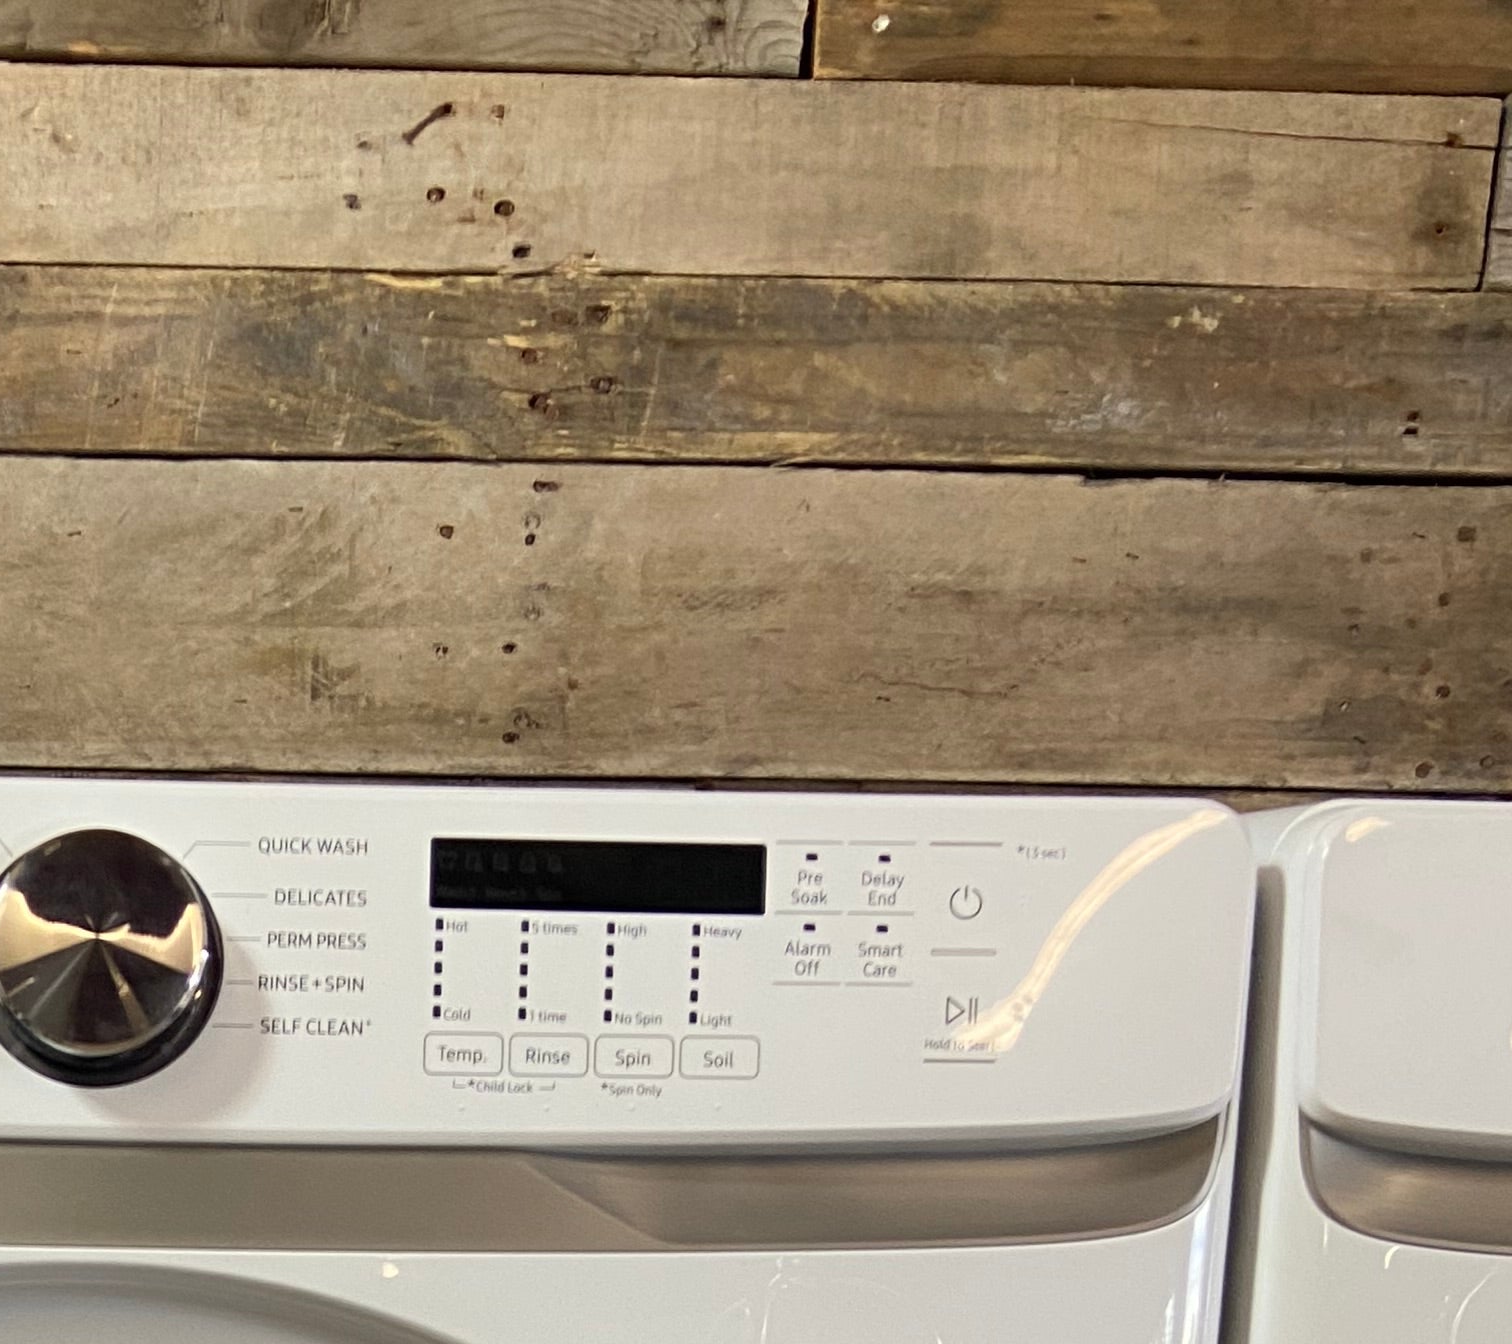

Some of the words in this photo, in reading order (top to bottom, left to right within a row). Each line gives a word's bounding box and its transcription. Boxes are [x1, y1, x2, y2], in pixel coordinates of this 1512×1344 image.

[257, 836, 313, 856] QUICK
[315, 838, 369, 856] WASH
[797, 868, 824, 886] Pre
[861, 870, 905, 892] Delay
[273, 887, 368, 908] DELICATES
[790, 887, 829, 906] Soak
[867, 889, 897, 907] End
[445, 920, 469, 933] Hot
[542, 921, 579, 935] times
[617, 924, 648, 938] High
[703, 925, 743, 940] Heavy
[267, 930, 313, 949] PERM
[316, 932, 368, 950] PRESS
[784, 938, 832, 957] Alarm
[857, 941, 904, 959] Smart
[794, 958, 821, 977] Off
[862, 960, 898, 978] Care
[257, 973, 310, 993] RINSE
[324, 974, 366, 993] SPIN
[442, 1007, 472, 1022] Cold
[537, 1008, 568, 1023] time
[614, 1012, 633, 1025] No
[635, 1011, 664, 1027] Spin
[699, 1014, 733, 1030] Light
[259, 1016, 303, 1036] SELF
[438, 1044, 489, 1065] Temp.
[524, 1046, 572, 1065] Rinse
[614, 1048, 652, 1070] Spin
[702, 1049, 735, 1070] Soil
[507, 1080, 534, 1095] Lock
[636, 1083, 663, 1099] Only
